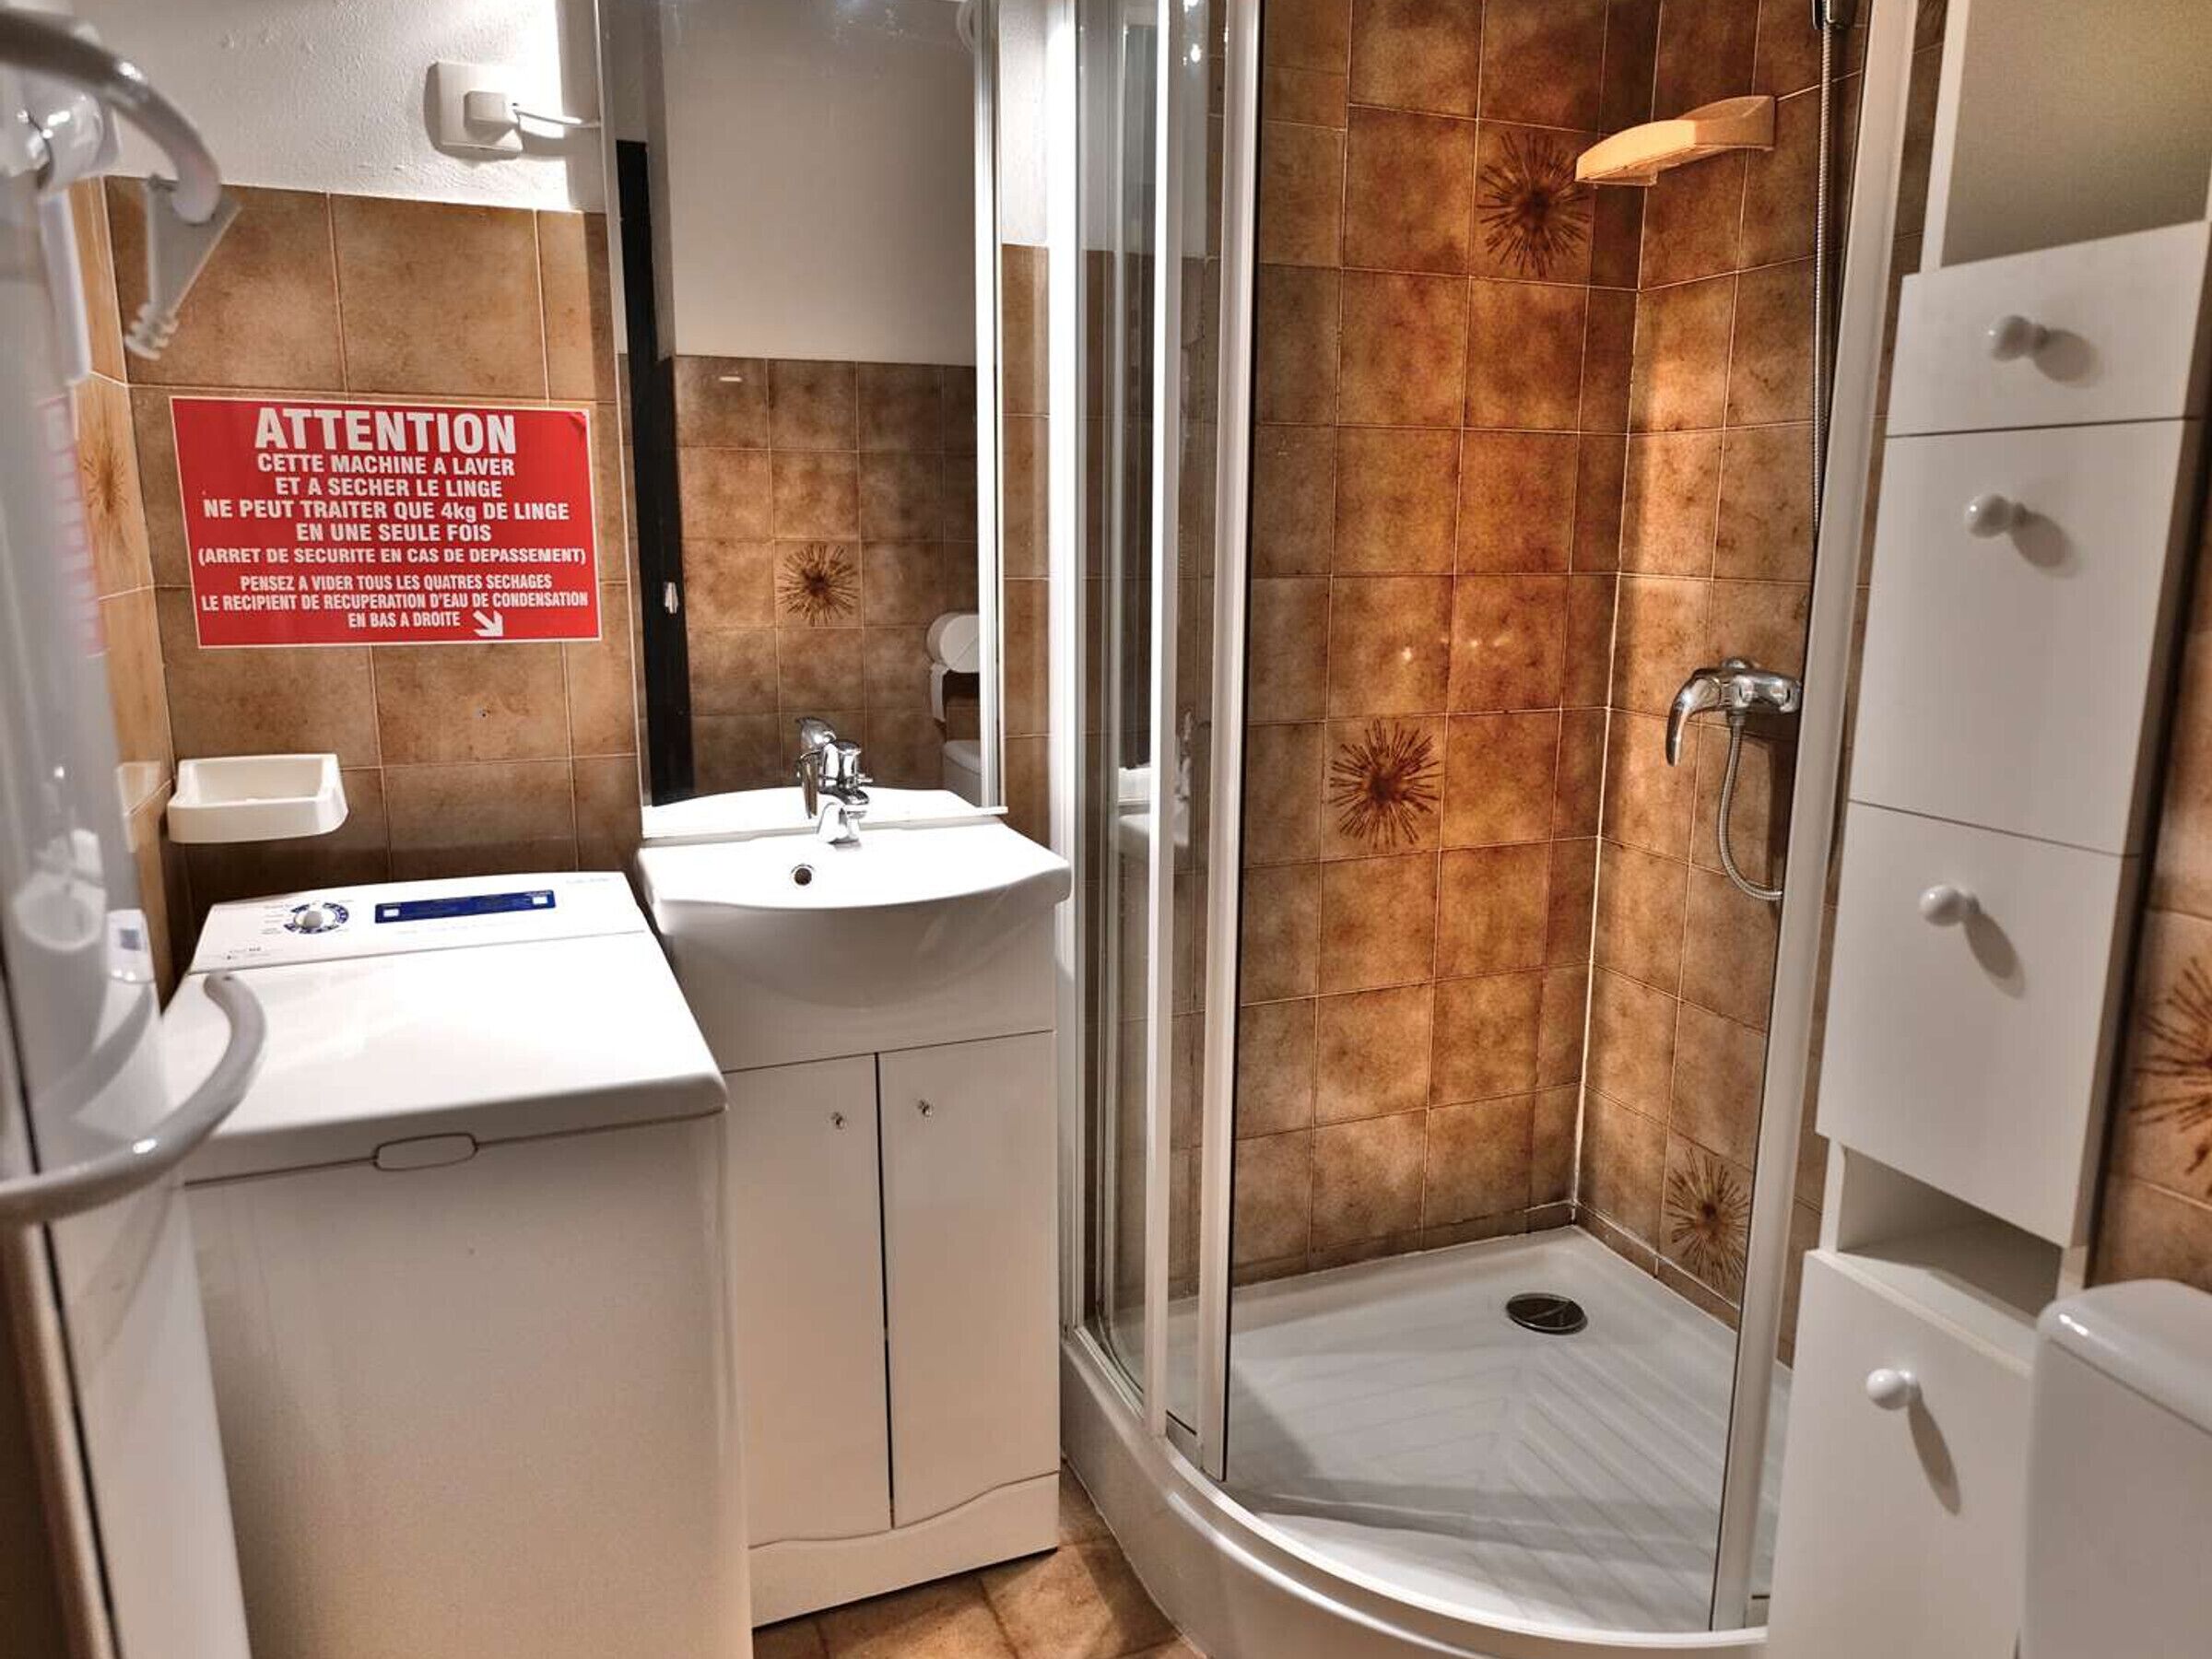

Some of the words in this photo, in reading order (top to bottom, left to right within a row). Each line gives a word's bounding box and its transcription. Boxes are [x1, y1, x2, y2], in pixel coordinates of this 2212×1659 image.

[254, 407, 516, 454] ATTENTION
[258, 453, 324, 473] CETTE
[331, 455, 427, 474] MACHINE
[433, 457, 446, 475] A
[453, 458, 515, 476] LAVER
[276, 477, 300, 495] ET
[308, 477, 322, 496] A
[328, 478, 409, 497] SECHER
[417, 479, 439, 497] LE
[446, 480, 502, 498] LINGE
[203, 500, 233, 518] NE
[240, 500, 294, 518] PEUT
[300, 501, 387, 519] TRAITER
[394, 502, 434, 521] QUE
[441, 502, 477, 523] 4kg
[483, 503, 508, 520] DE
[514, 503, 569, 520] LINGE
[296, 524, 324, 541] EN
[331, 524, 371, 541] UNE
[379, 524, 440, 541] SEULE
[447, 524, 491, 541] FOIS
[198, 548, 261, 566] (ARRET
[266, 548, 288, 563] DE
[294, 548, 375, 563] SECURITE
[382, 549, 402, 562] EN
[407, 548, 439, 562] CAS
[444, 548, 465, 562] DE
[470, 548, 586, 564] DEPASSEMENT)
[241, 576, 295, 591] PENSEZ
[299, 576, 308, 591] A
[312, 576, 353, 590] VIDER
[356, 575, 393, 590] TOUS
[396, 575, 420, 590] LES
[424, 574, 482, 590] QUATRES
[487, 574, 552, 589] SECHAGES
[202, 595, 218, 611] LE
[223, 594, 297, 610] RECIPIENT
[301, 594, 320, 609] DE
[324, 594, 426, 609] RECUPERATION
[430, 593, 468, 607] D'EAU
[473, 593, 488, 607] DE
[492, 592, 588, 606] CONDENSATION
[348, 613, 366, 628] EN
[371, 612, 395, 628] BAS
[400, 612, 409, 627] A
[413, 611, 461, 627] DROITE
